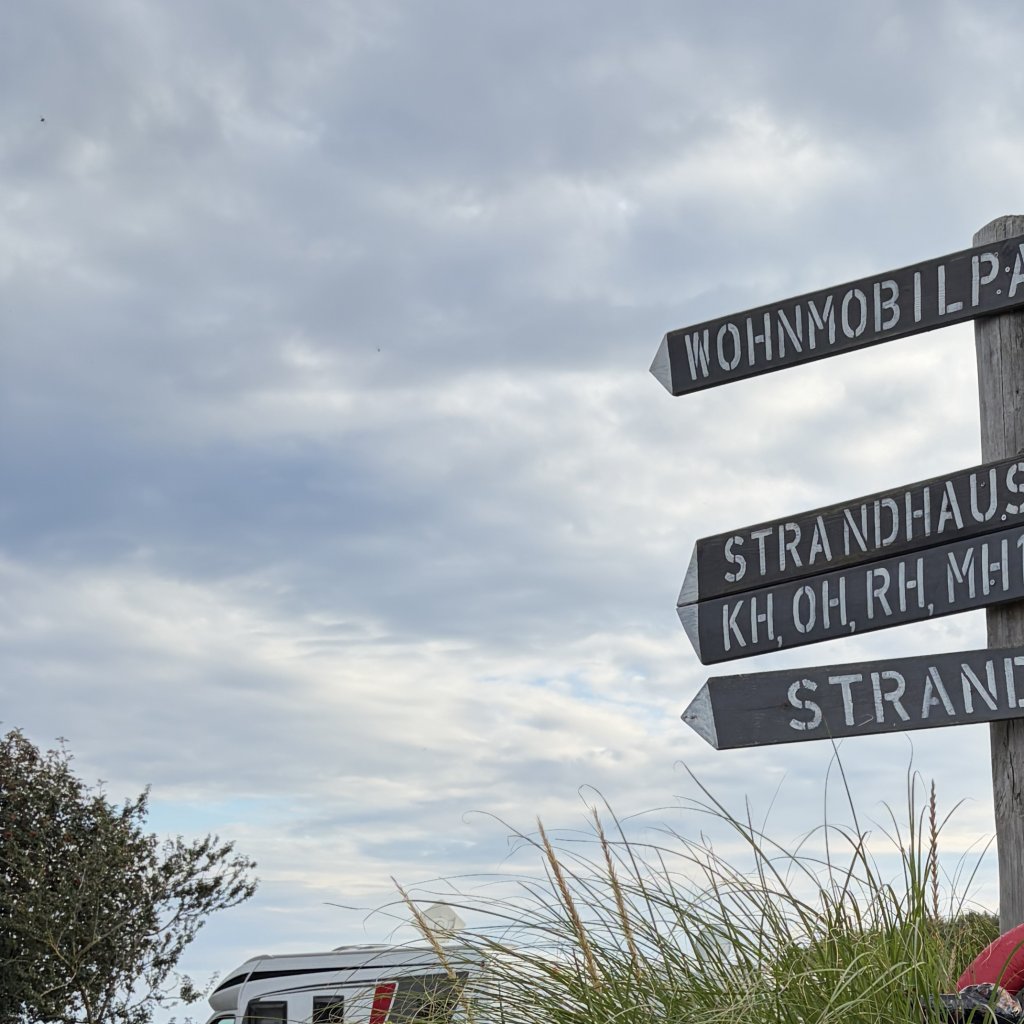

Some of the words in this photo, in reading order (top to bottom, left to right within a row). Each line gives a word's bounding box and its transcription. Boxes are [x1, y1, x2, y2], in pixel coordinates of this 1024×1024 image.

[722, 593, 784, 651] KH,
[792, 576, 857, 634] OH,
[866, 558, 934, 619] RH,
